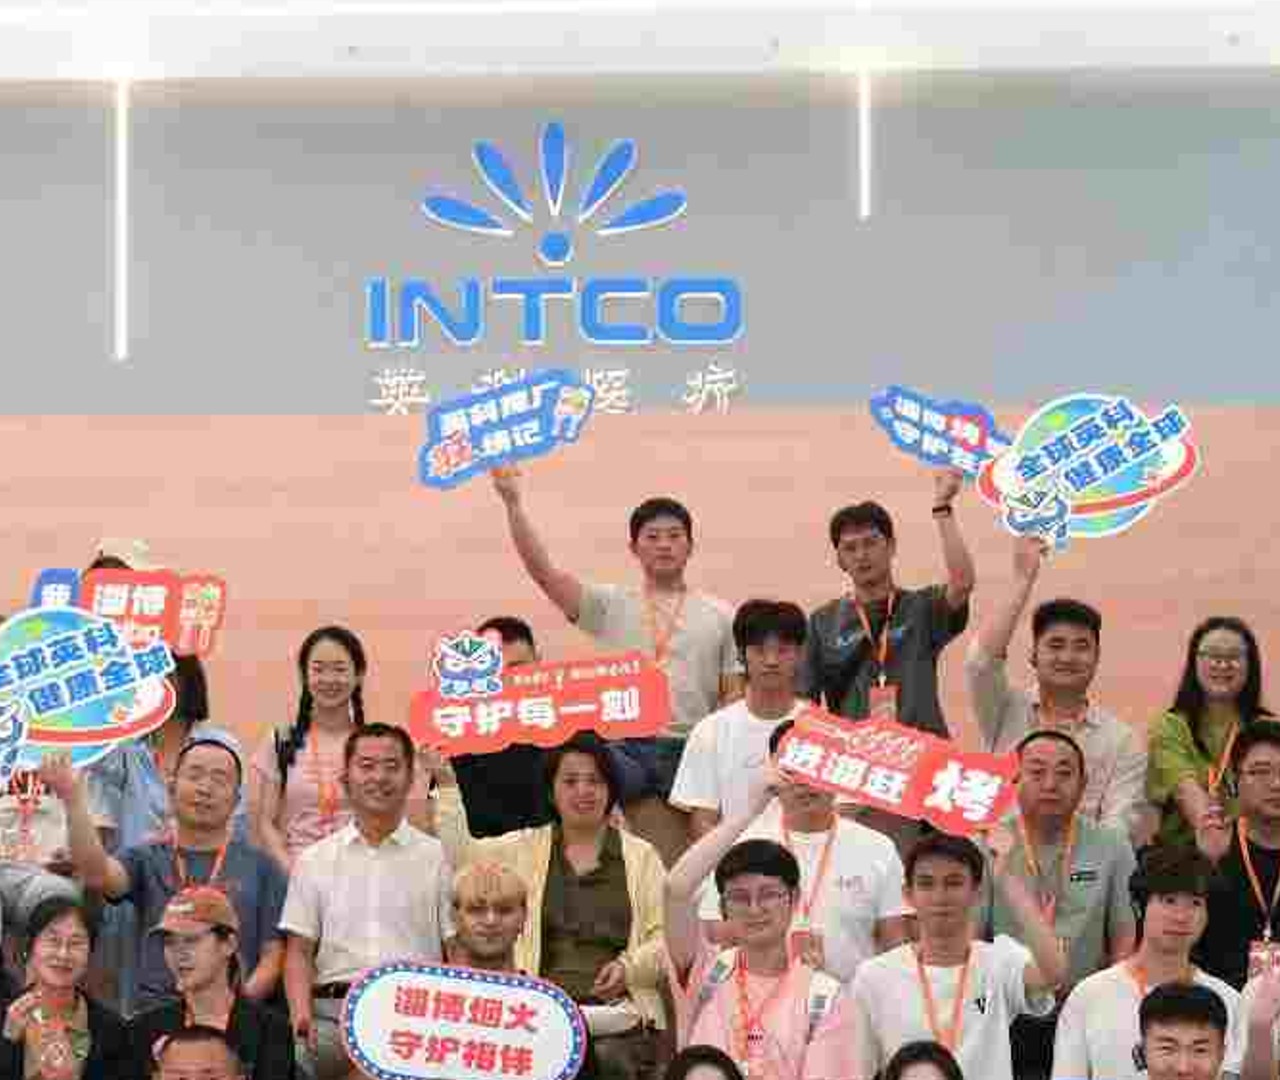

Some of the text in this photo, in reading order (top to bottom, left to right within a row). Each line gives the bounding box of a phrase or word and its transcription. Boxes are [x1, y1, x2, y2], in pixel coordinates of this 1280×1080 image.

[366, 277, 744, 346] INTCO
[1019, 400, 1135, 479] 全球英科
[1065, 410, 1186, 491] 健康全球
[28, 643, 169, 714] 健康全球
[431, 687, 640, 738] 守护每一刻
